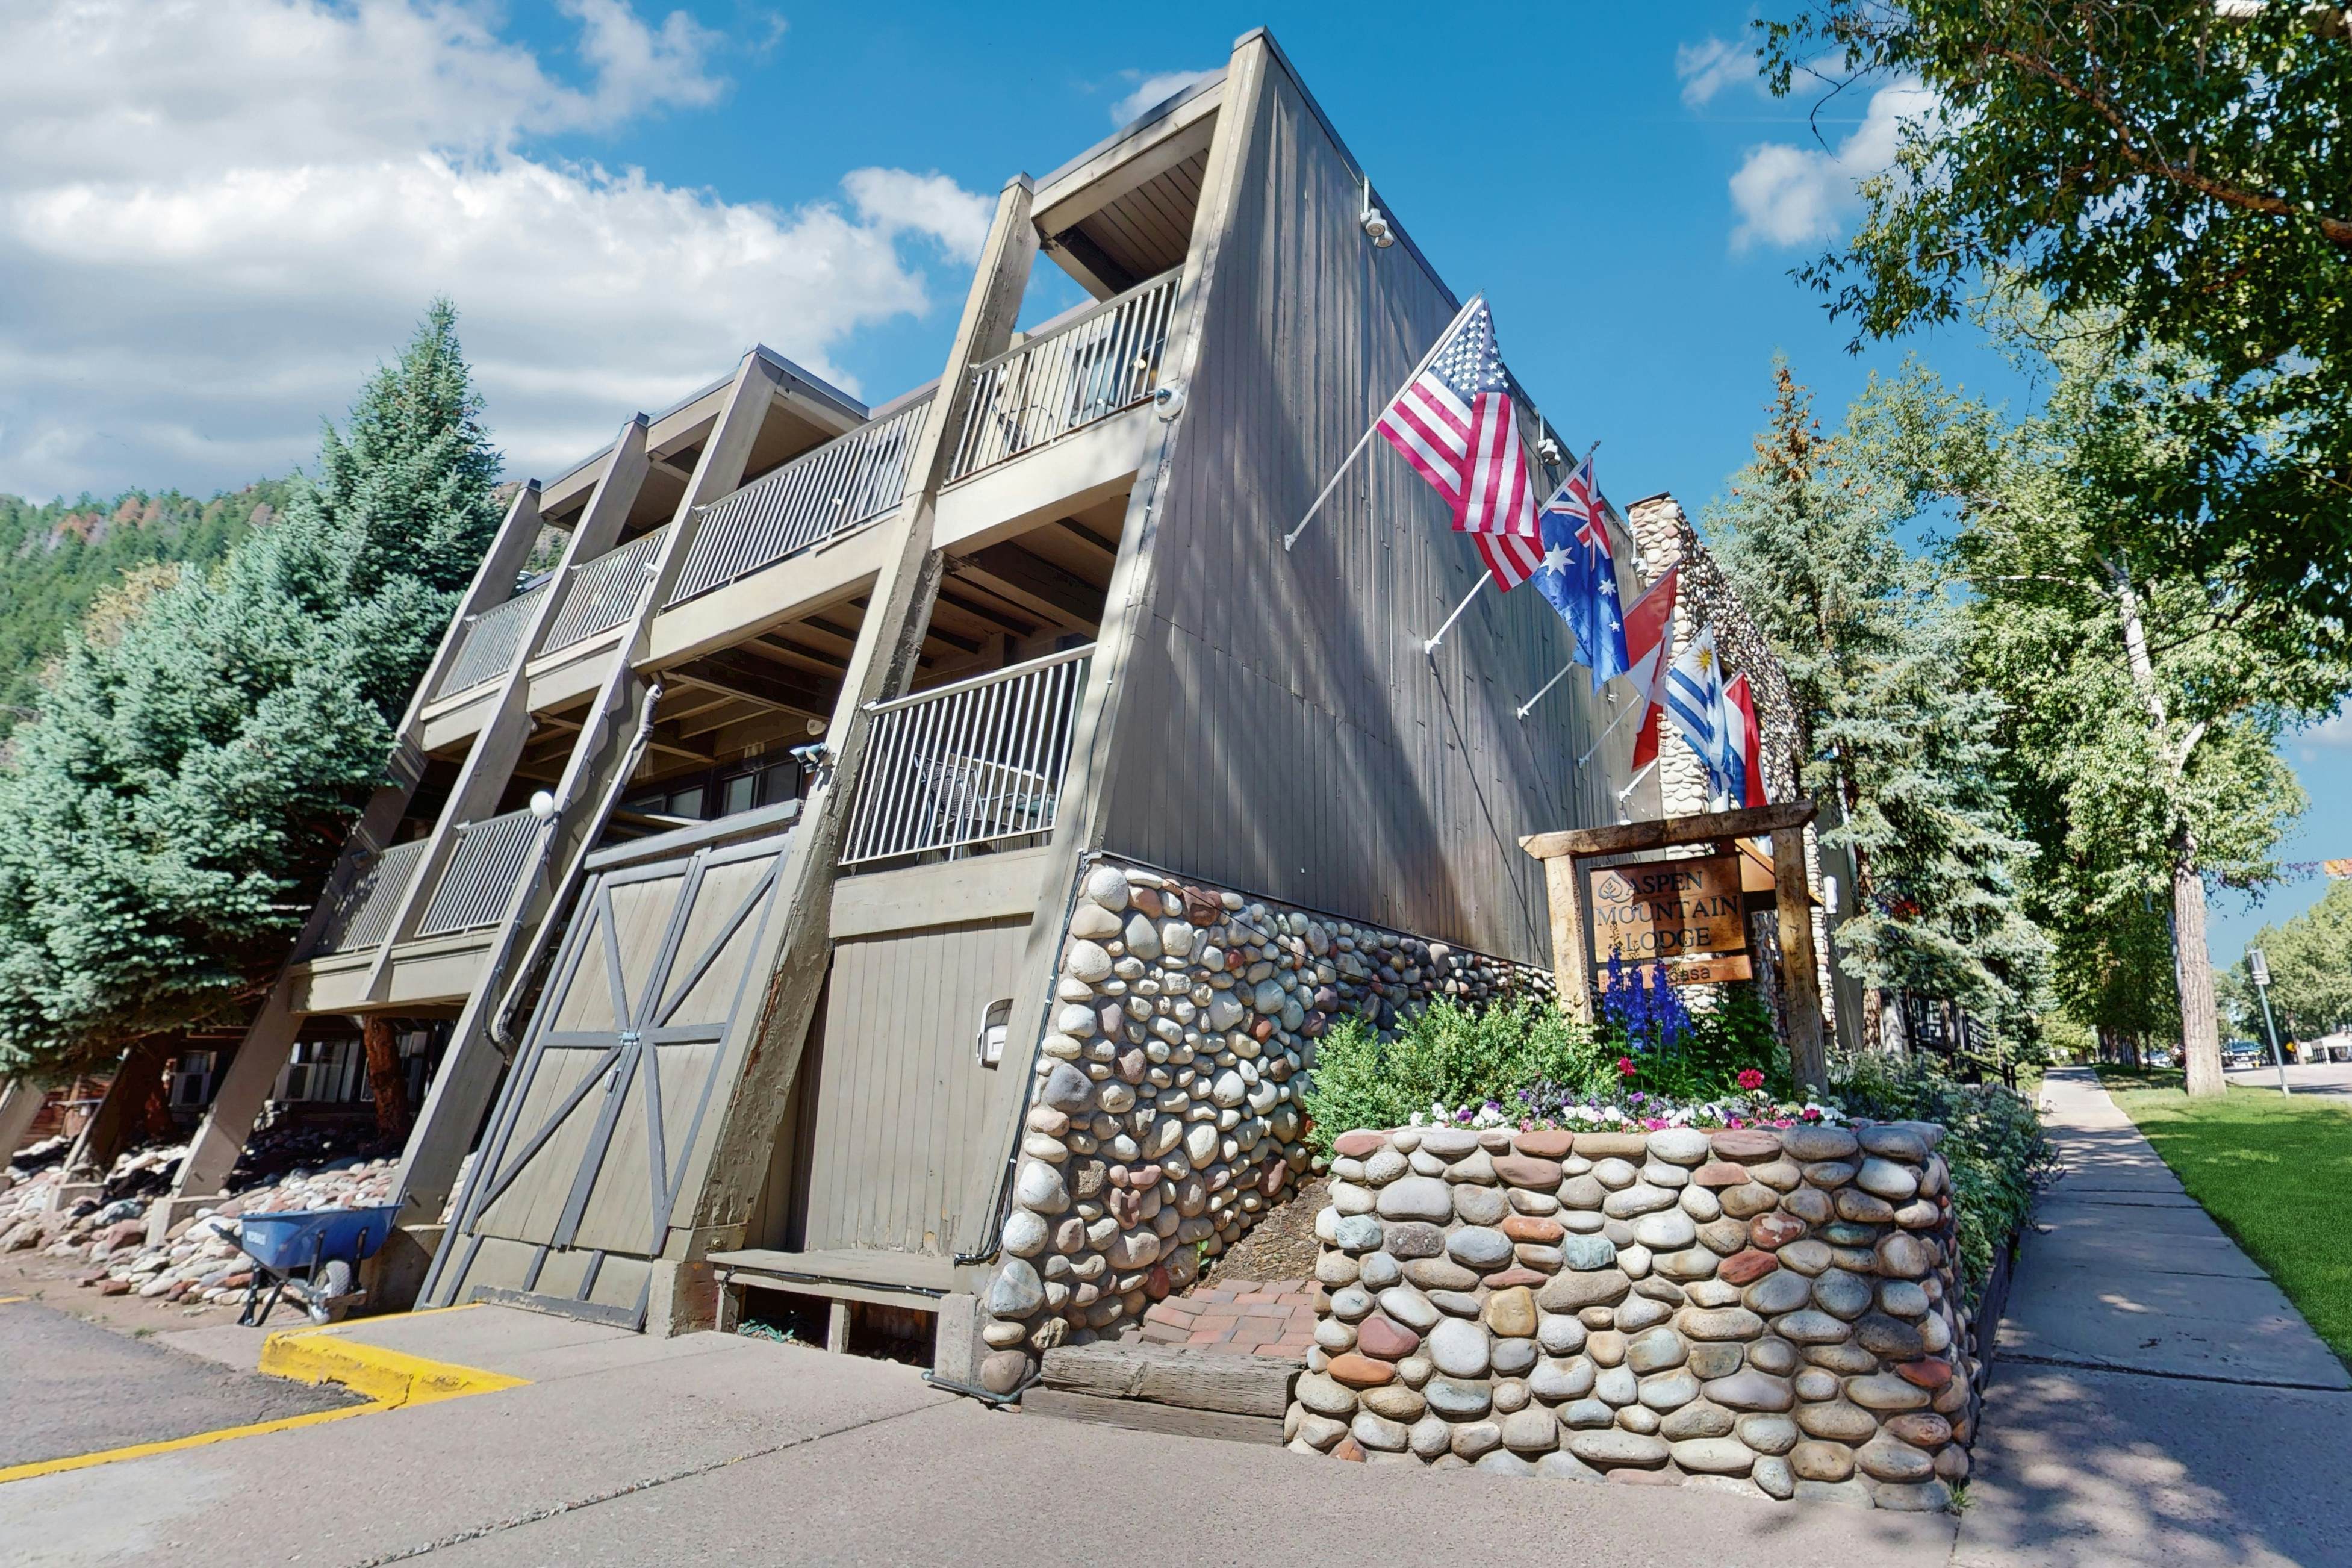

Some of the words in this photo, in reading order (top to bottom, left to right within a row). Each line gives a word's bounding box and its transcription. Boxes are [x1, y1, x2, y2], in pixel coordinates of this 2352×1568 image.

[1626, 870, 1703, 896] ASPEN
[1596, 895, 1738, 926] MOUNTAIN
[1626, 927, 1712, 952] LODGE
